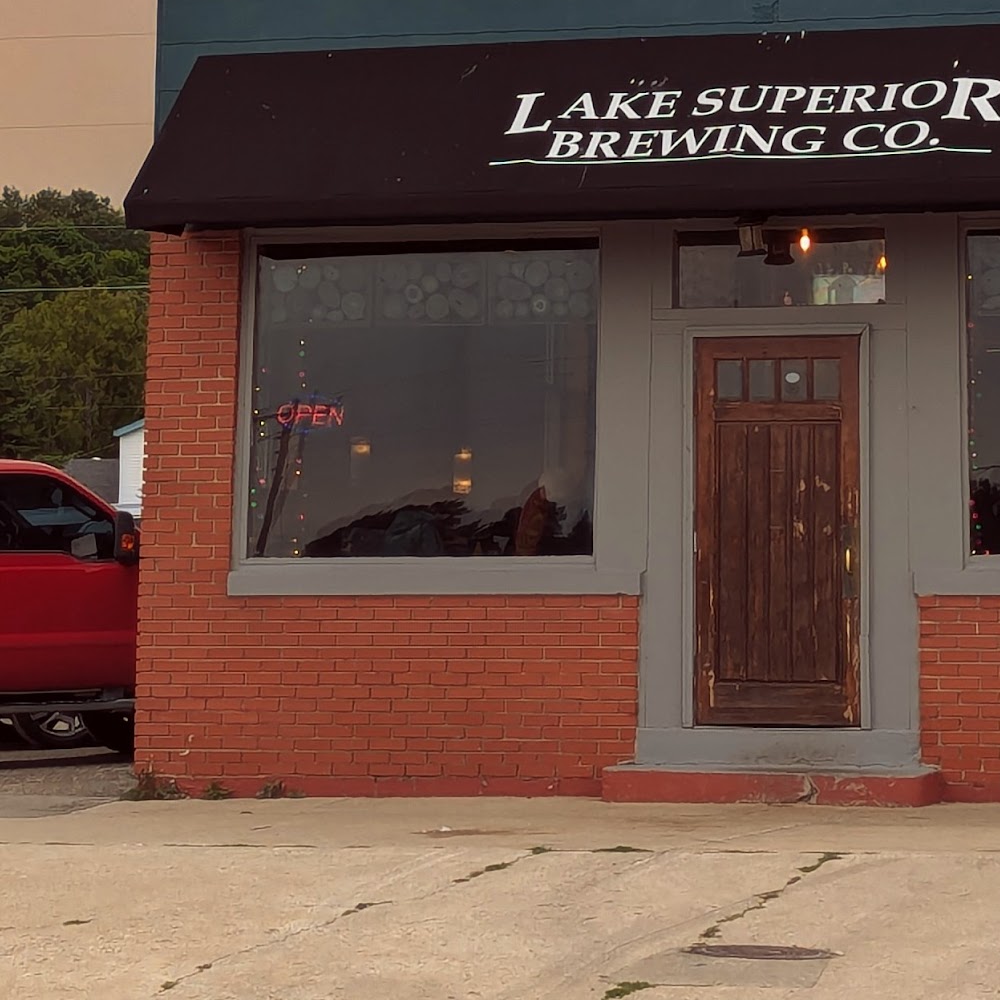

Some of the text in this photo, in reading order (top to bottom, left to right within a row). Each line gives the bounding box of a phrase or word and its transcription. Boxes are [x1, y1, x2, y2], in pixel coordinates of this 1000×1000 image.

[504, 90, 682, 134] LAKE
[545, 120, 940, 158] BREWING CO.
[276, 403, 345, 426] OPEN
